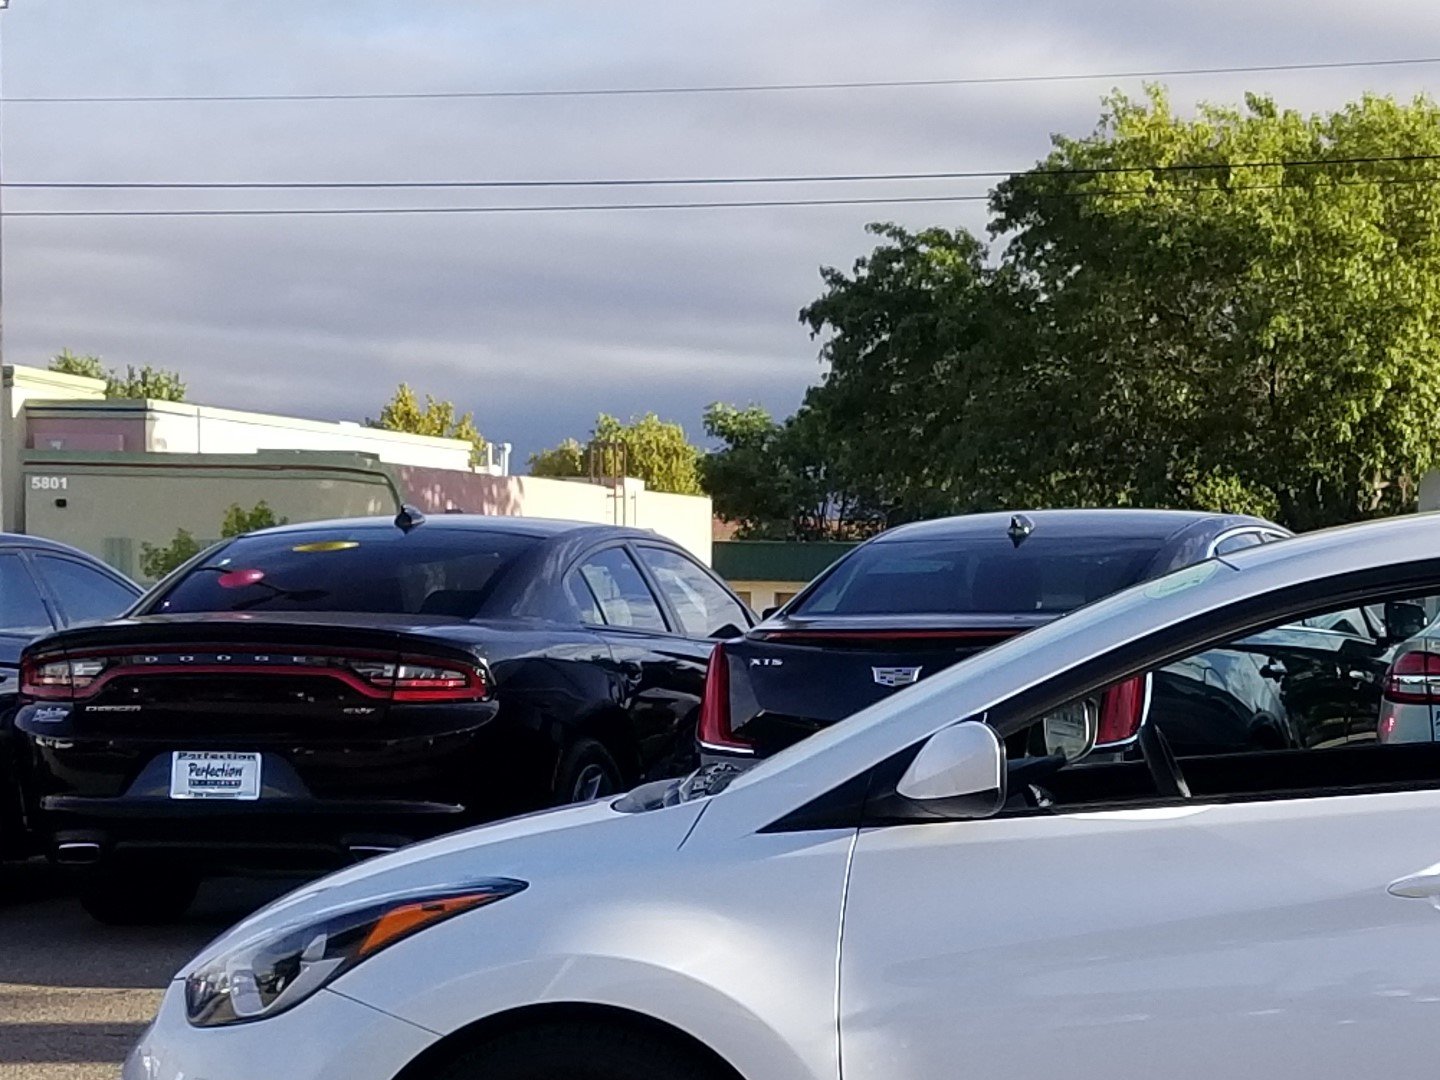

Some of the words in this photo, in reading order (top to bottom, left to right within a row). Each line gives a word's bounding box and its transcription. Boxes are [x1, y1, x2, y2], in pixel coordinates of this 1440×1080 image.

[31, 476, 67, 490] 5801
[144, 655, 307, 663] DODGE
[188, 762, 244, 779] Perfection
